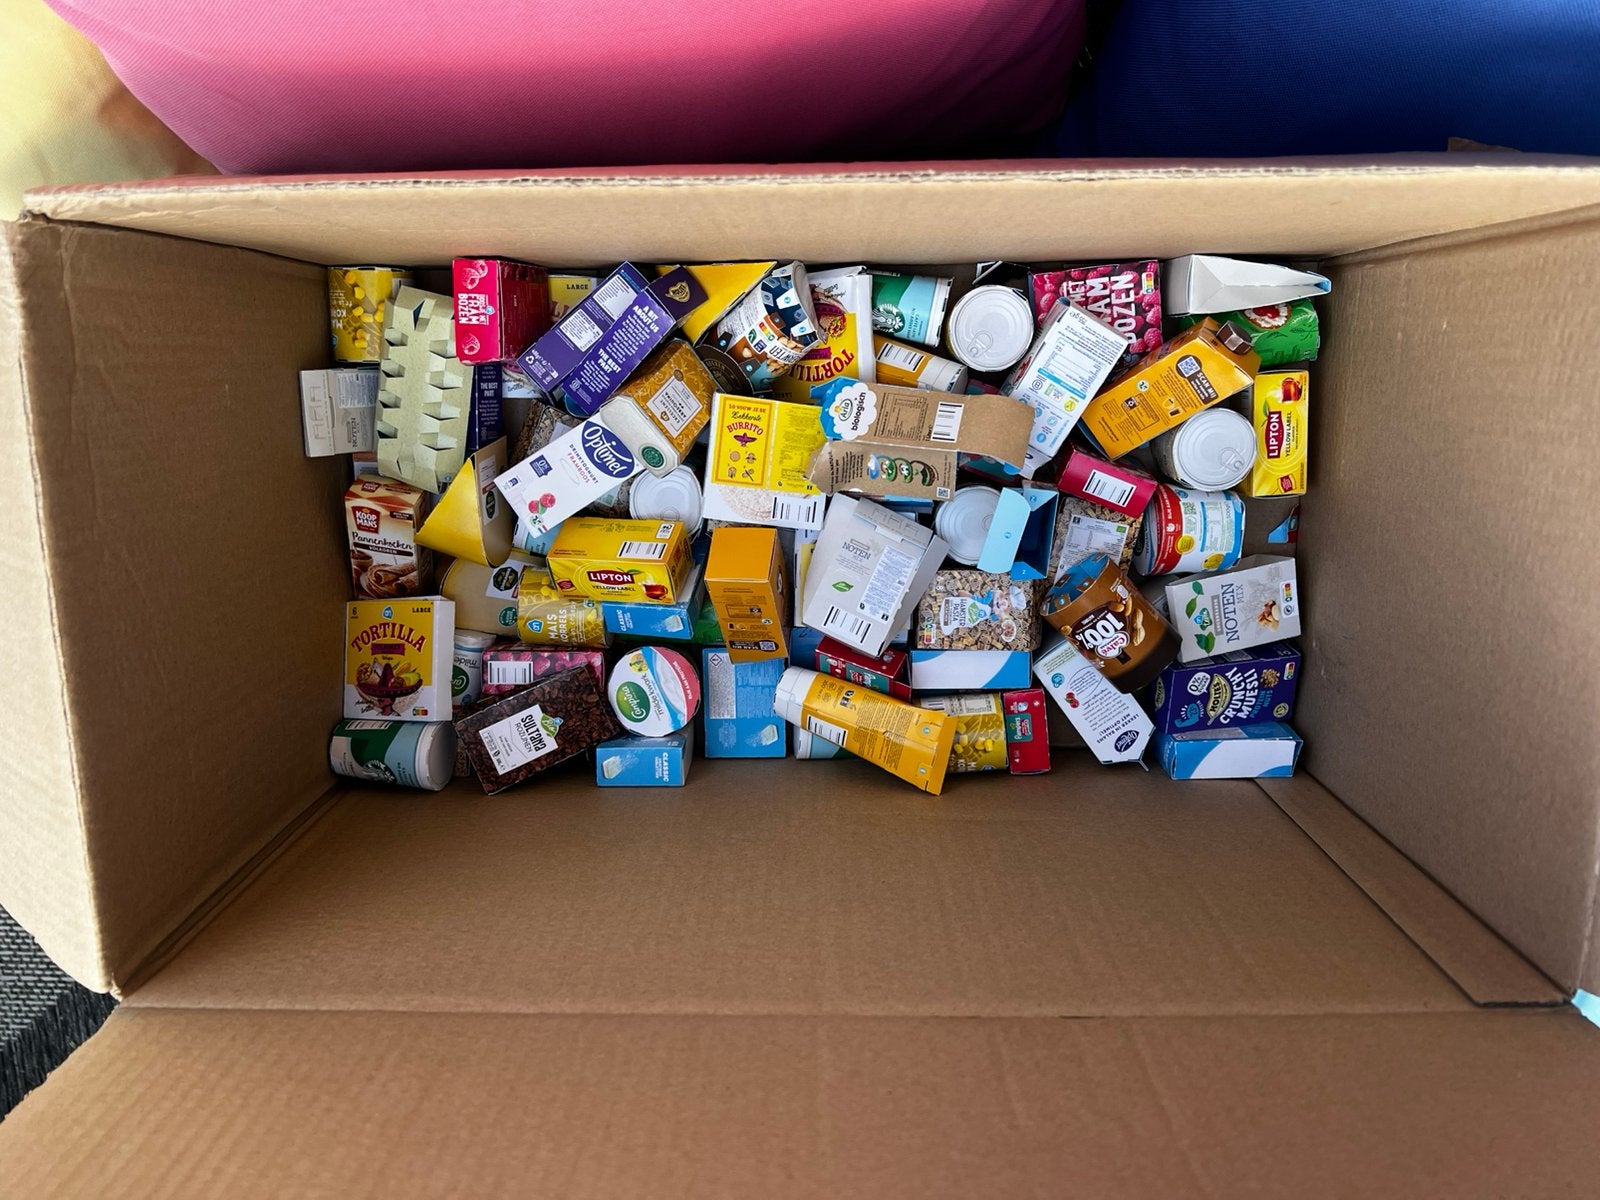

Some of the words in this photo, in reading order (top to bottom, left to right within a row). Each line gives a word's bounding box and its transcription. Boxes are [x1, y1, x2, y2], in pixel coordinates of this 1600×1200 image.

[458, 293, 470, 324] BOZEN
[468, 294, 480, 324] FRAM
[632, 304, 652, 326] ABOUT
[650, 323, 659, 333] US
[646, 310, 659, 322] BIT
[597, 348, 610, 361] THE
[606, 358, 622, 374] BEST
[597, 358, 612, 374] PART
[1196, 371, 1210, 389] SCAN
[1206, 387, 1217, 399] MIJ
[731, 411, 762, 421] Lekkerste
[840, 402, 850, 418] Arla
[847, 391, 868, 432] biologisch
[727, 422, 764, 435] BURRITO
[1269, 414, 1280, 456] LIPTON
[584, 426, 632, 475] Optimel
[567, 453, 590, 484] FRAMBOOS
[356, 511, 377, 521] KOOP
[357, 519, 377, 528] MANS
[352, 532, 412, 550] Pannenkoeken
[842, 541, 871, 560] NOTEN
[590, 573, 632, 582] LIPTON
[1234, 584, 1245, 604] MIX
[352, 607, 357, 616] 6
[1221, 583, 1239, 643] NOTEN
[351, 622, 426, 652] TORTILLA
[546, 614, 560, 639] MAIS
[1074, 610, 1126, 653] 100%
[1100, 636, 1127, 657] Calvé
[640, 673, 656, 696] kwark
[1188, 675, 1201, 693] 0%
[1220, 667, 1245, 724] CRUNCHY
[1237, 668, 1259, 719] MUESLI
[620, 683, 647, 721] Campina
[650, 694, 665, 716] milde
[1251, 690, 1265, 718] PROTEIN
[1264, 690, 1273, 707] NUTS
[1014, 716, 1022, 740] Pampers
[1121, 713, 1131, 722] MET
[1121, 713, 1140, 728] LEKKER
[514, 722, 533, 753] ROZIJNEN
[520, 713, 547, 752] SULTANA
[1096, 729, 1115, 744] BALANS
[1117, 732, 1138, 749] Optimel
